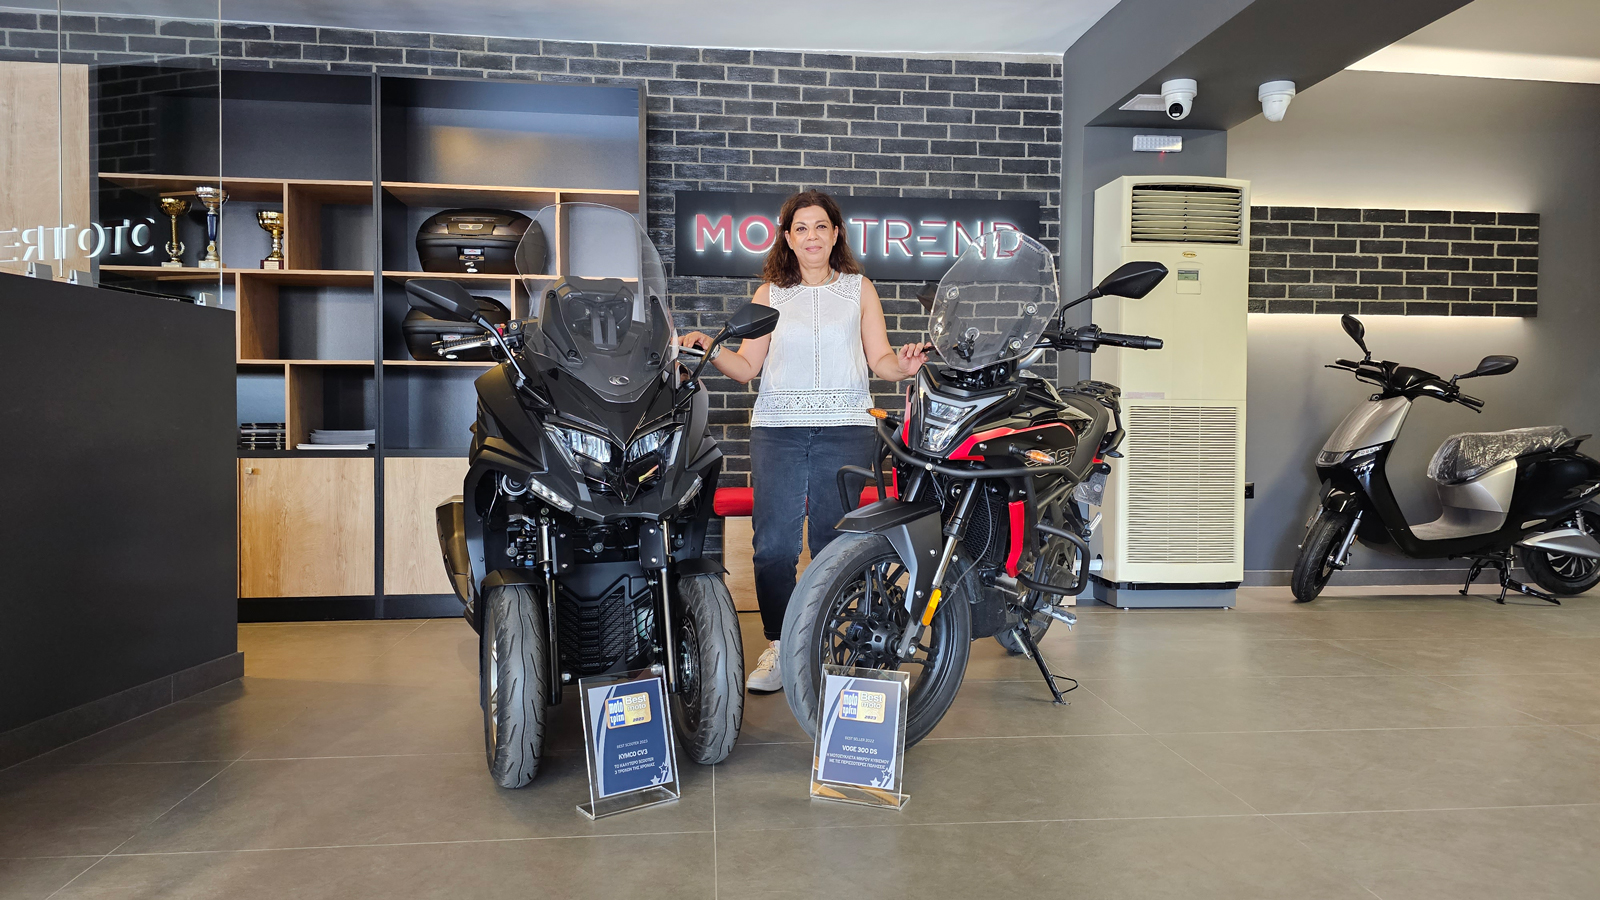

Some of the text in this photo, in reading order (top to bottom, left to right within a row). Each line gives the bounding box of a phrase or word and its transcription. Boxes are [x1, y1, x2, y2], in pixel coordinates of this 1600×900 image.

[625, 695, 646, 704] Best
[843, 693, 858, 706] moto
[861, 692, 883, 702] Best
[608, 700, 624, 714] moto
[861, 701, 881, 709] moto
[857, 746, 870, 754] 300
[618, 751, 636, 760] KYMCO
